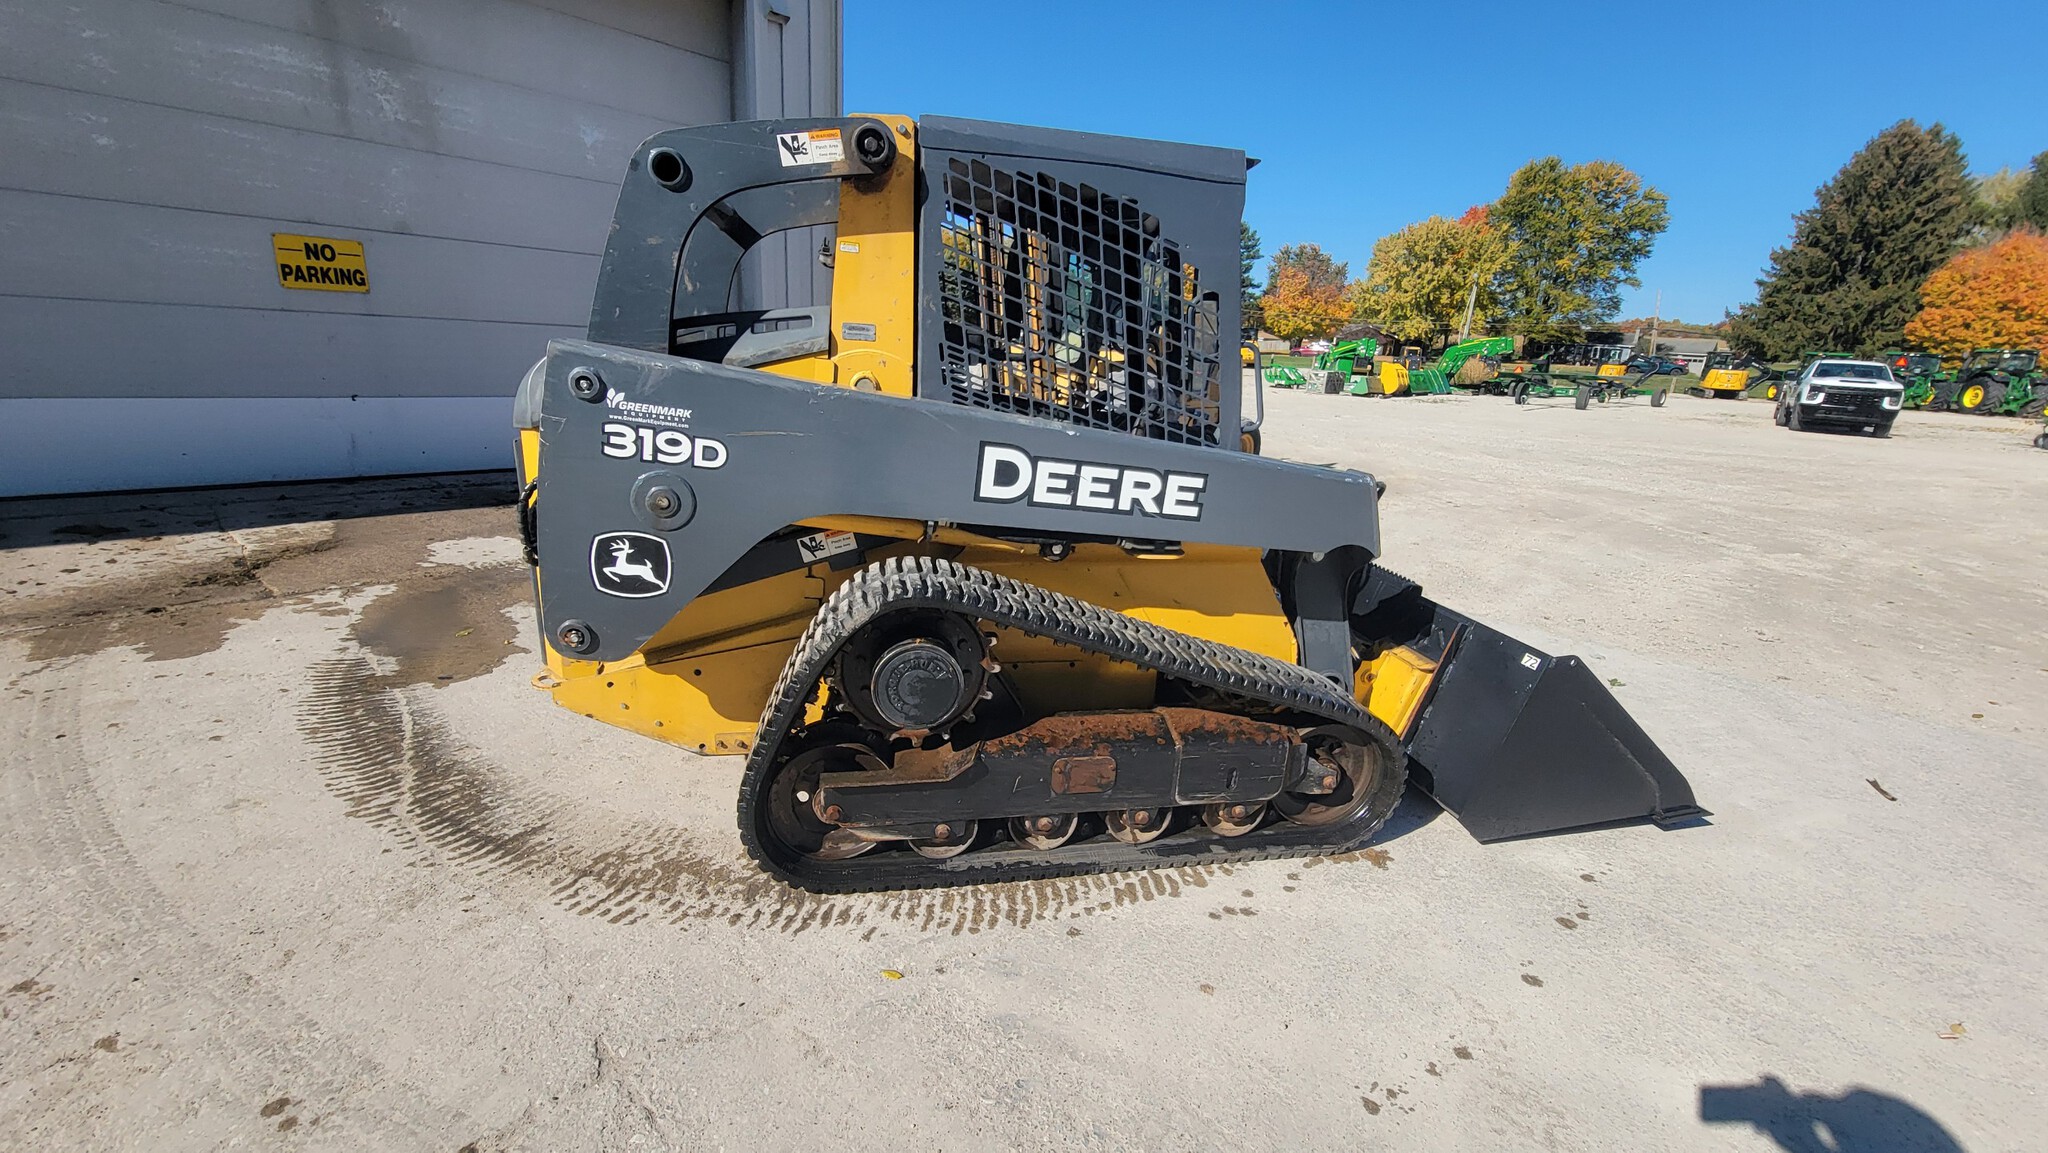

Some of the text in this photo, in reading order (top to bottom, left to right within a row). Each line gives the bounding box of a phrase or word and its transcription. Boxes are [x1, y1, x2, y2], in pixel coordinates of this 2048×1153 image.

[303, 242, 337, 262] NO
[280, 263, 367, 287] PARKING
[618, 401, 692, 419] GREENMARK
[623, 410, 686, 422] EQUIPMENT
[608, 414, 690, 429] www.GreenMarkEquipment.com
[603, 423, 728, 469] 319D
[979, 446, 1205, 518] DEERE
[1524, 654, 1539, 669] 72
